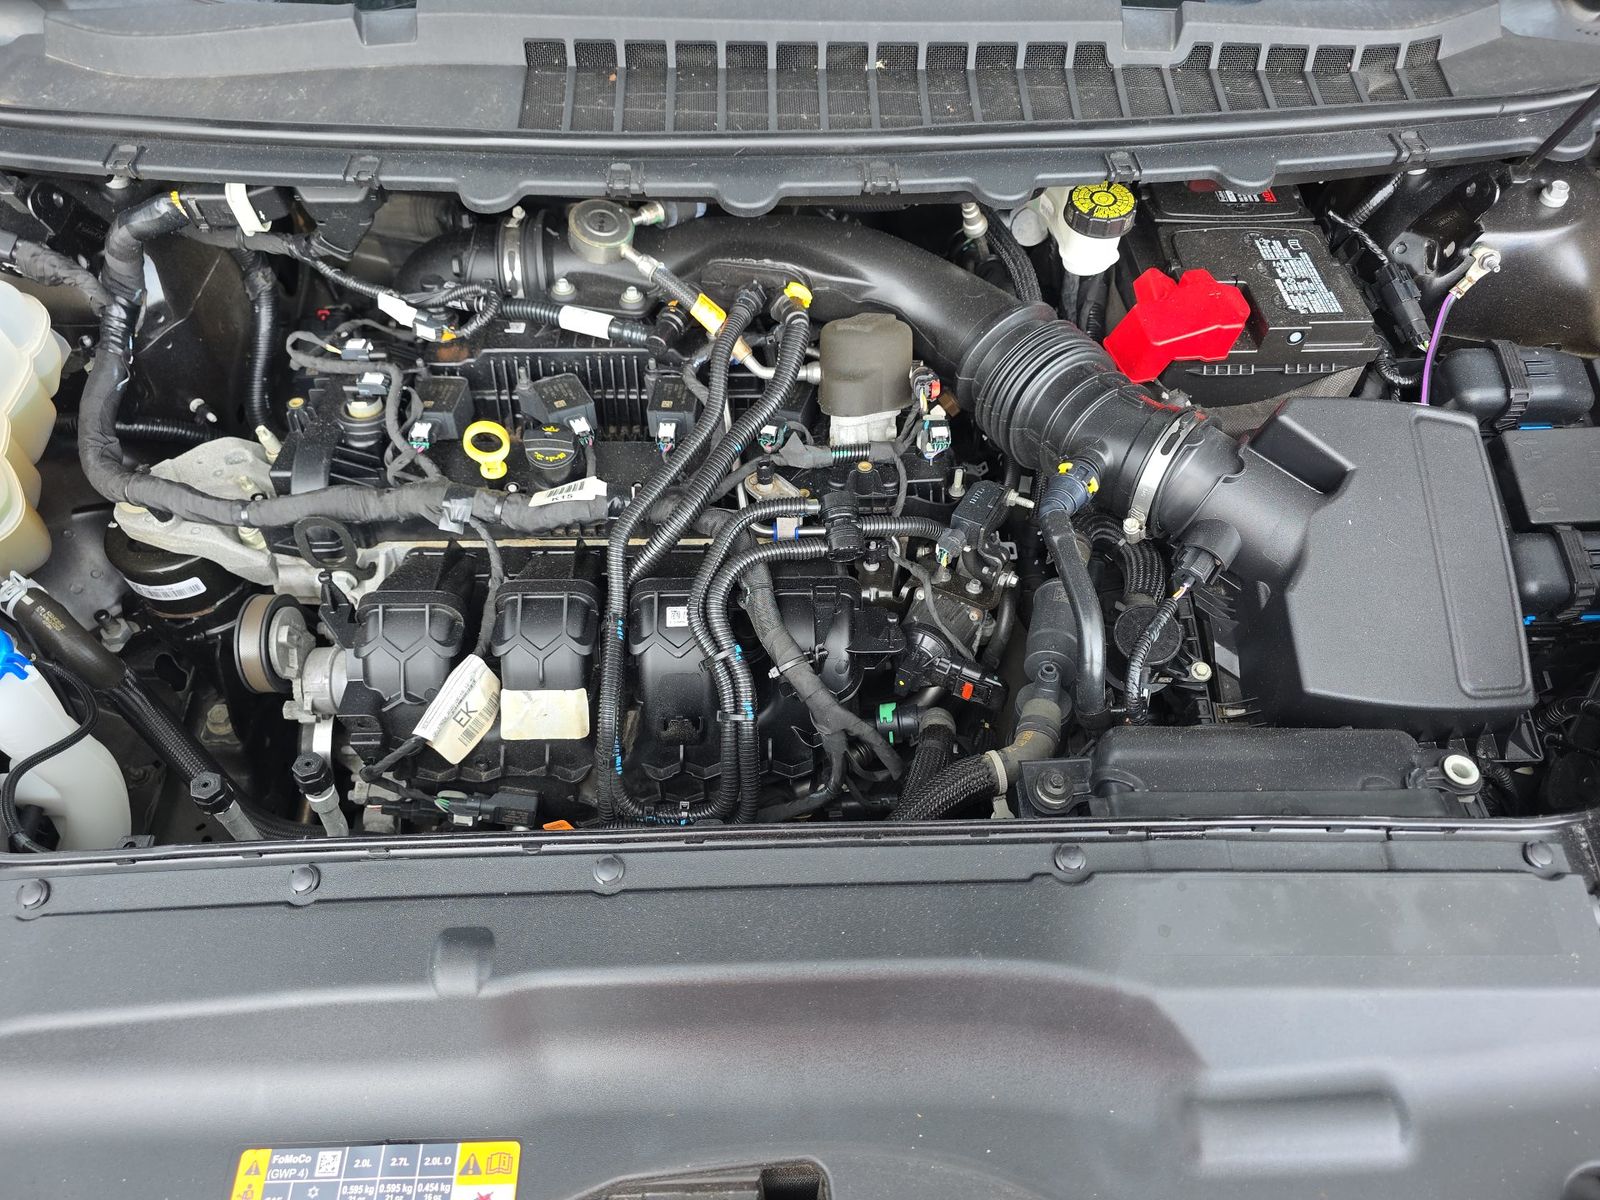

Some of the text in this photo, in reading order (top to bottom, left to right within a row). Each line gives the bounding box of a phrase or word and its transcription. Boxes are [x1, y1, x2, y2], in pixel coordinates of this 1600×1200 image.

[452, 701, 478, 728] EK
[272, 1154, 312, 1164] FoMoCo
[353, 1159, 372, 1168] 2.0L
[390, 1157, 410, 1167] 2.7L
[423, 1156, 452, 1166] 2.0L D
[267, 1168, 309, 1180] (GWP 4)
[342, 1185, 375, 1196] 0.595 kg
[378, 1184, 413, 1195] 0.595 kg
[417, 1182, 451, 1194] 0.454 kg
